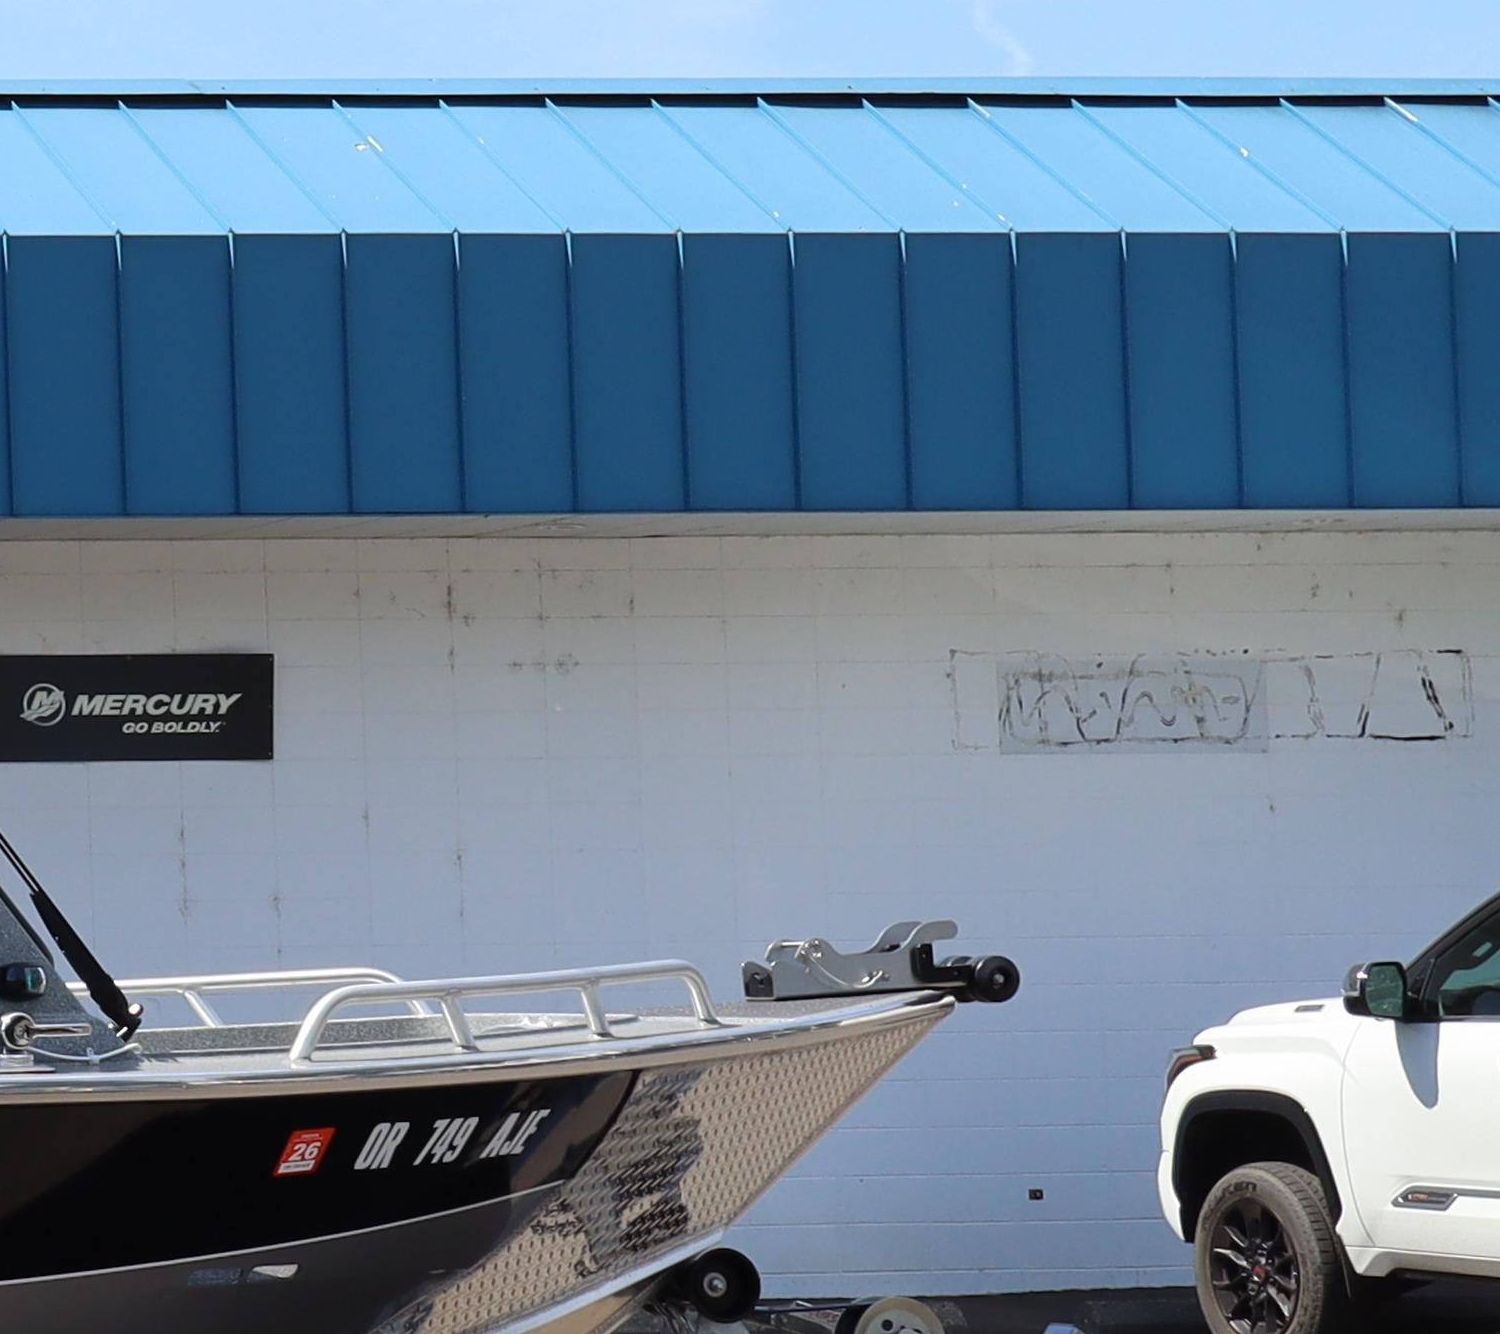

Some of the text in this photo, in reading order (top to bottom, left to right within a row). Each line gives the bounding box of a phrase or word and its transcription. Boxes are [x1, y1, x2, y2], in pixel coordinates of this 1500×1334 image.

[71, 694, 242, 716] MERCURY
[122, 722, 149, 734] GO
[288, 1141, 321, 1161] 26
[354, 1121, 410, 1170] OR
[412, 1116, 479, 1166] 749
